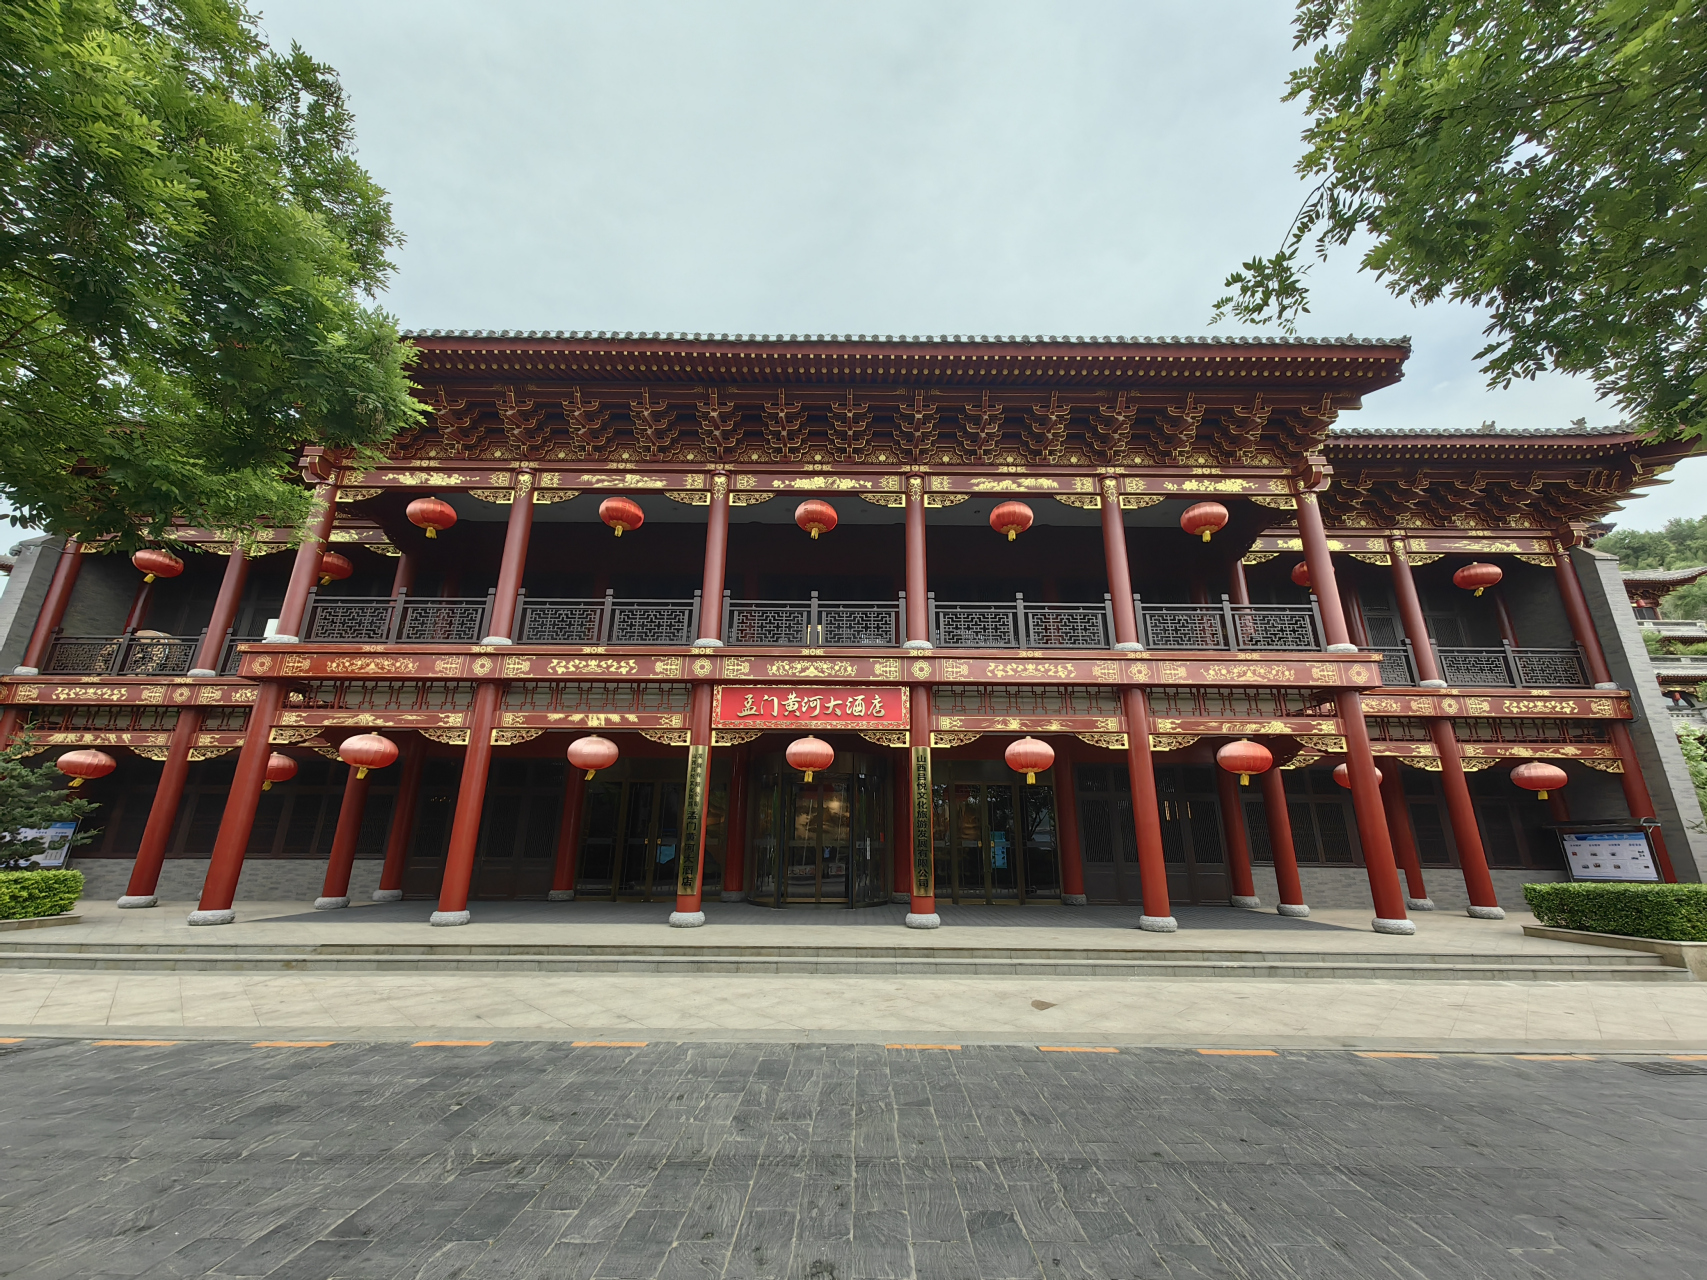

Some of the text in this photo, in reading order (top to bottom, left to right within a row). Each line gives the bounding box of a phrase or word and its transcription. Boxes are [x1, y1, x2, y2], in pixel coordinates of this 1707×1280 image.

[736, 690, 886, 718] 孟门黄河大酒店
[681, 810, 698, 887] 孟门黄河大酒店
[916, 754, 929, 888] 山西吕悦文化旅游发展有限公司
